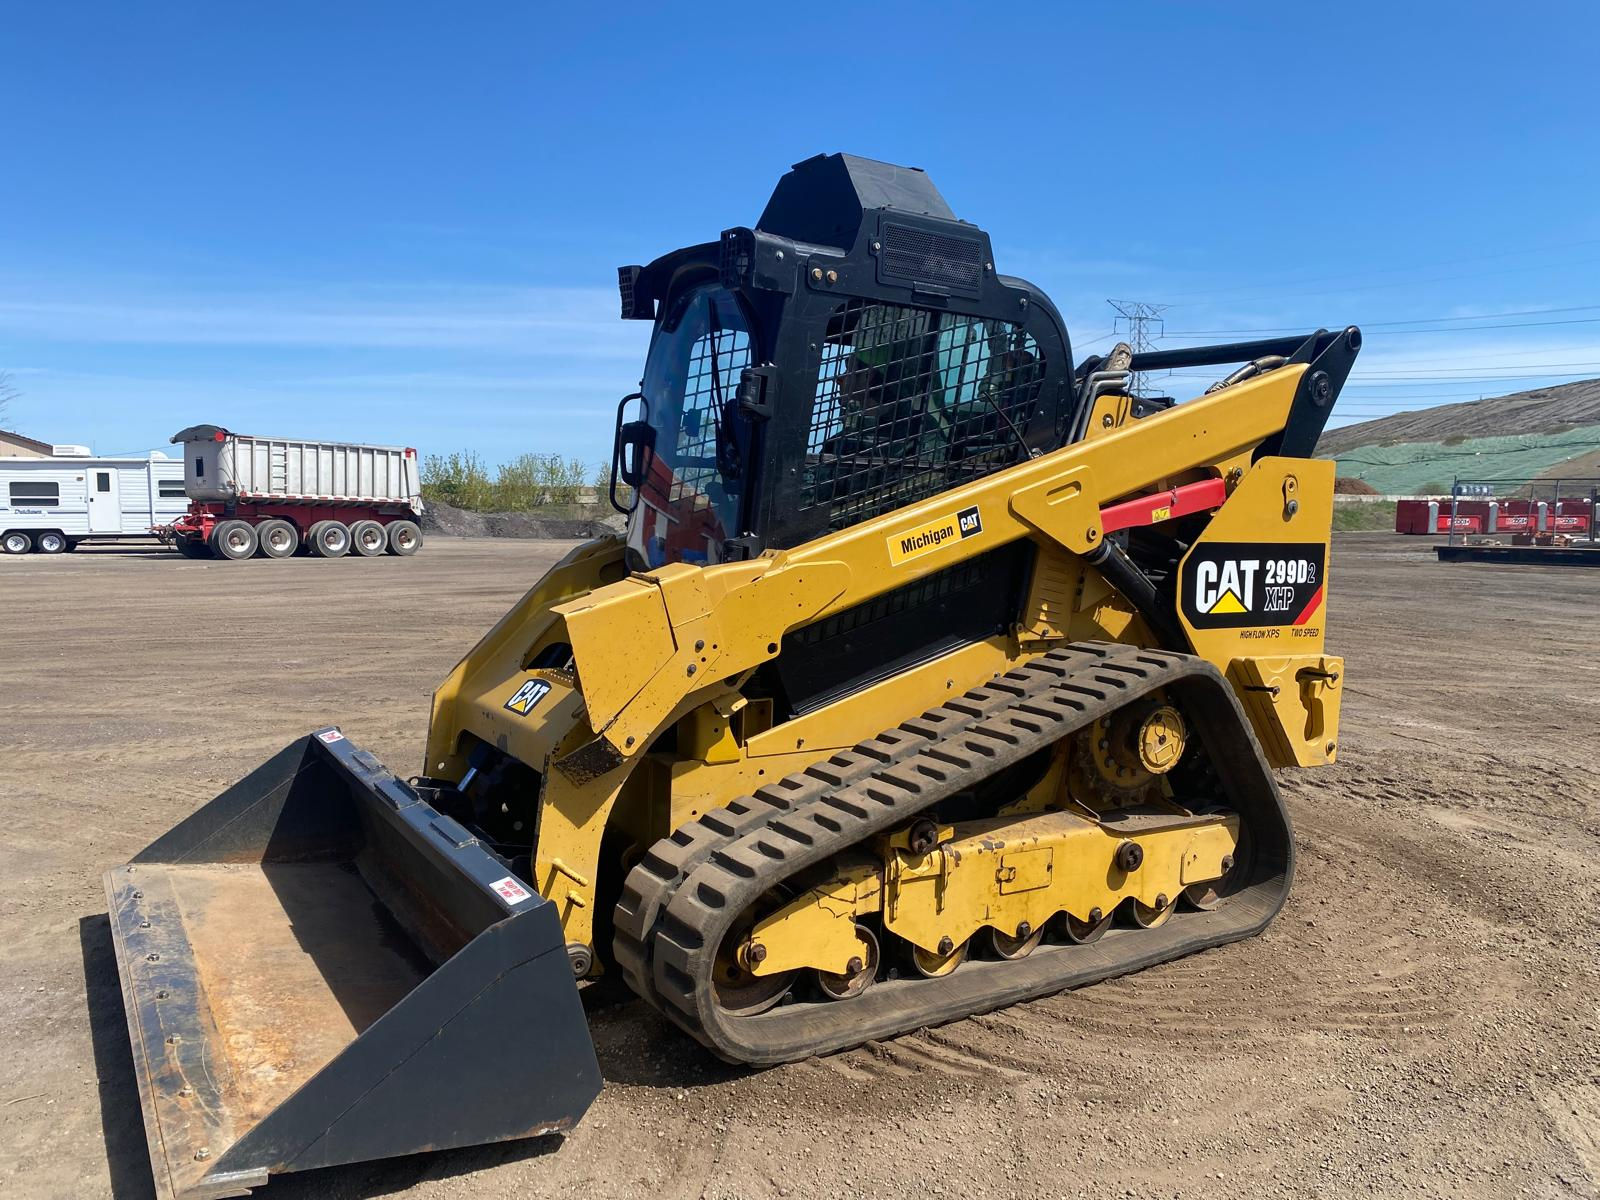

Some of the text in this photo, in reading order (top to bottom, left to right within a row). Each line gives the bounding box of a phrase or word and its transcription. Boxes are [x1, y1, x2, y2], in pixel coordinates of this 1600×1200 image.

[901, 513, 978, 554] Michigan CAT
[1196, 559, 1316, 614] CAT 299D2
[1264, 586, 1294, 611] XHP
[1240, 628, 1280, 639] HIGH FLOW XPS
[1291, 628, 1319, 637] TWO SPEED
[507, 680, 550, 713] CAT
